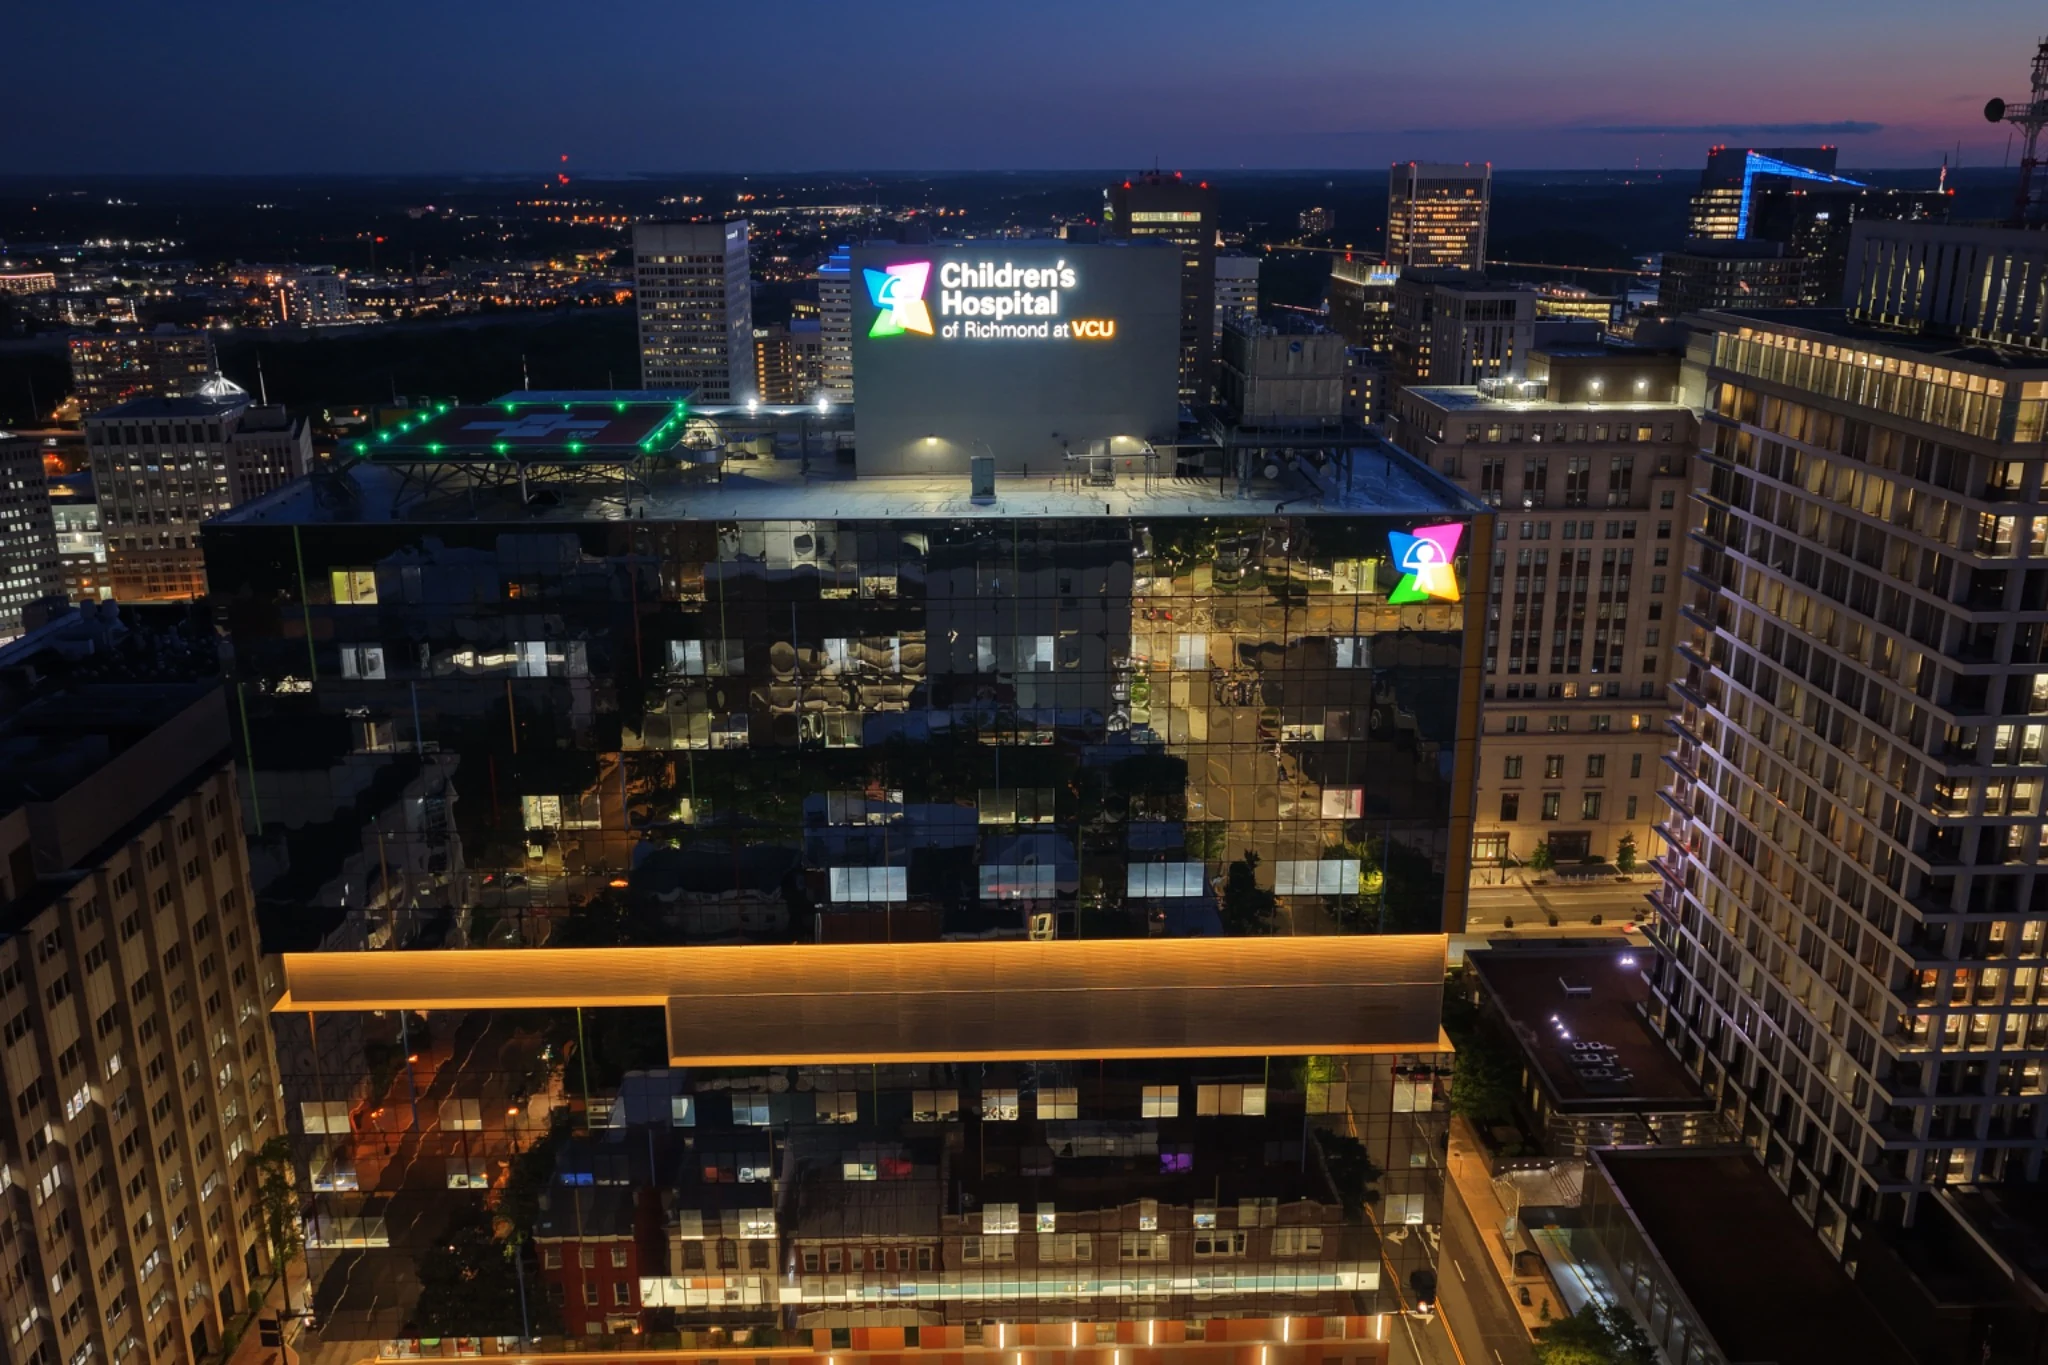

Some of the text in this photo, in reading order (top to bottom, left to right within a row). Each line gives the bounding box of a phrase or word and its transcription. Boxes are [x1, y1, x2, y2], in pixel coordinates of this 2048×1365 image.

[940, 260, 1077, 288] Children's
[941, 290, 1058, 320] Hospital
[942, 321, 1114, 338] of Richmond at VCU
